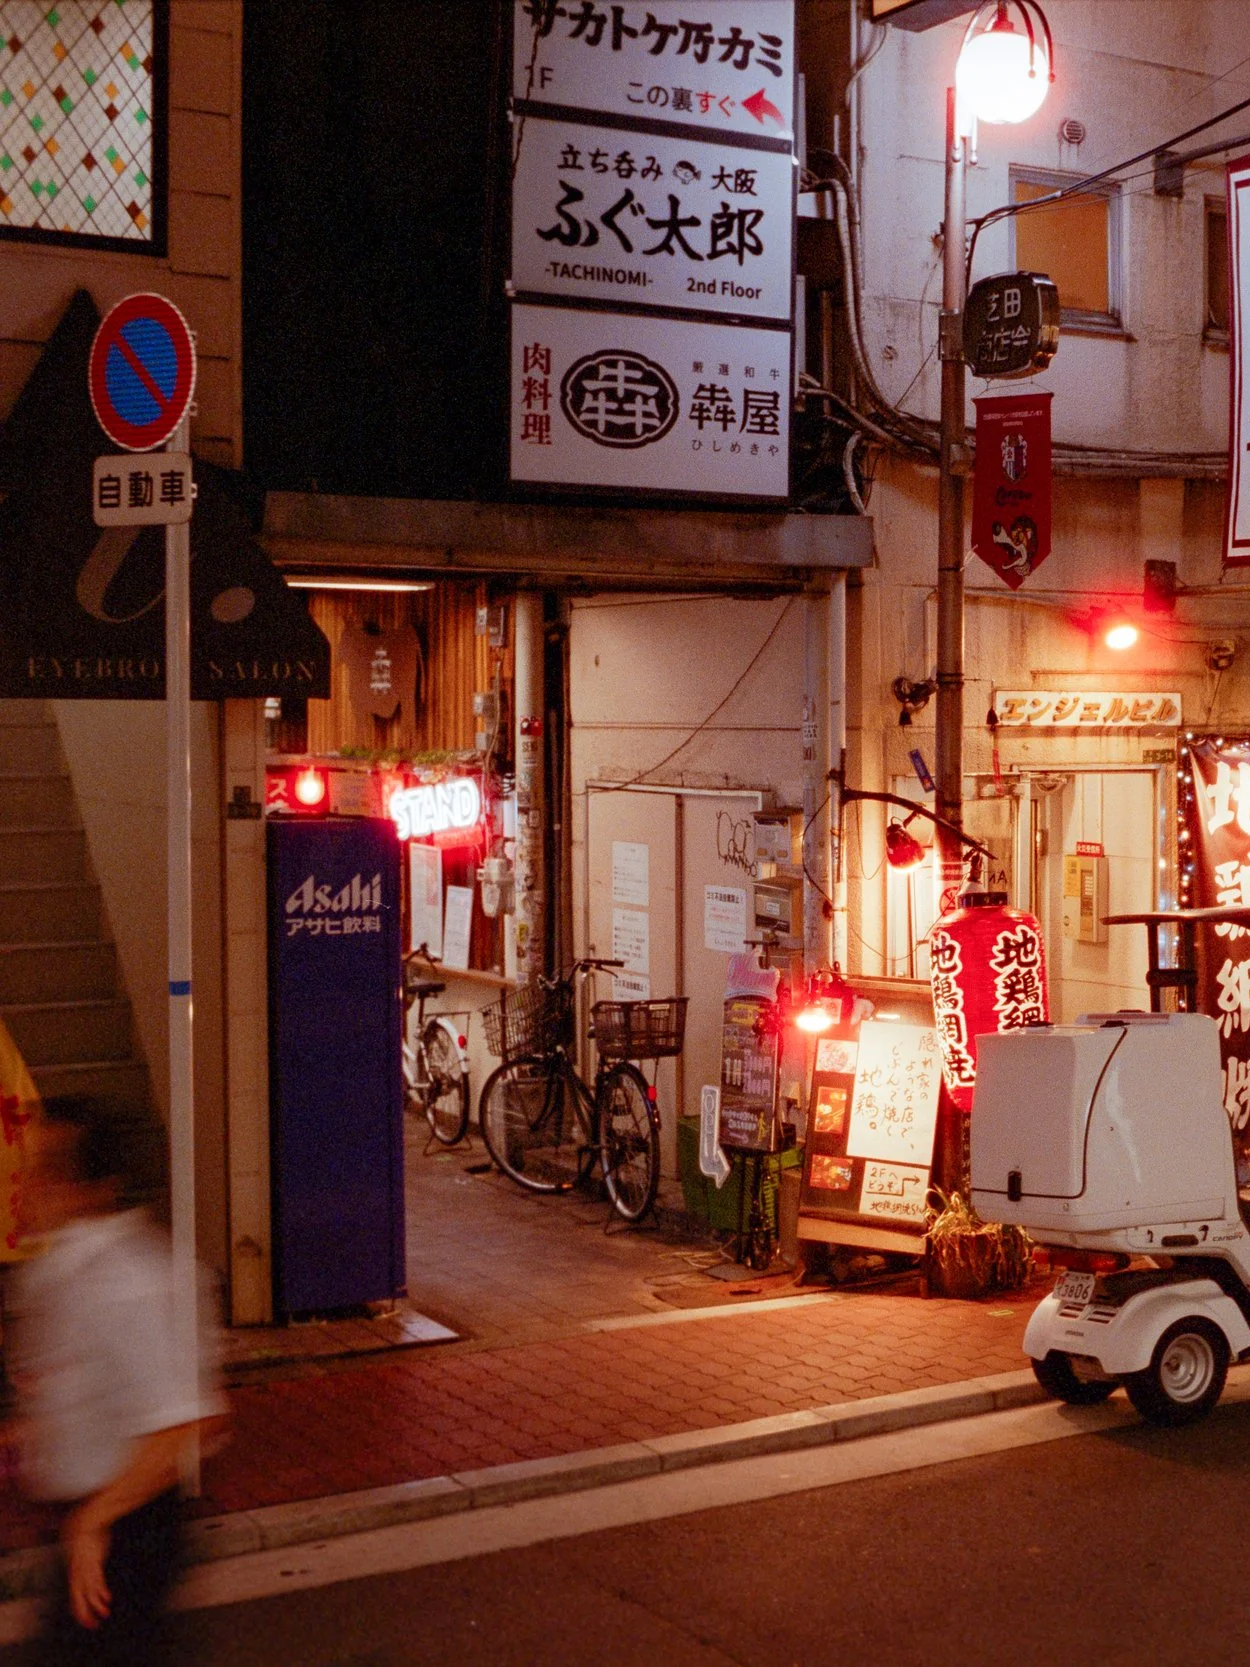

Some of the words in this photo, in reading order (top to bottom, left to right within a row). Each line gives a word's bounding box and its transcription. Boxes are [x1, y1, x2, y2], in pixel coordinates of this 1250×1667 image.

[627, 81, 735, 117] この裏すぐ
[558, 144, 663, 182] 立ち呑み
[711, 166, 757, 196] 大阪
[536, 180, 764, 266] ふぐ太郎
[687, 278, 716, 294] 2nd
[721, 281, 762, 300] Floor
[521, 342, 552, 446] 肉料理
[692, 439, 779, 456] ひしめきや
[99, 470, 186, 508] 自動車
[1000, 695, 1178, 723] エンジェルビル
[389, 777, 480, 841] STAND
[285, 872, 382, 914] Asahi
[286, 916, 381, 936] アサヒ飲料
[993, 928, 1043, 1031] 地鶏網
[1061, 1283, 1090, 1300] 3806
